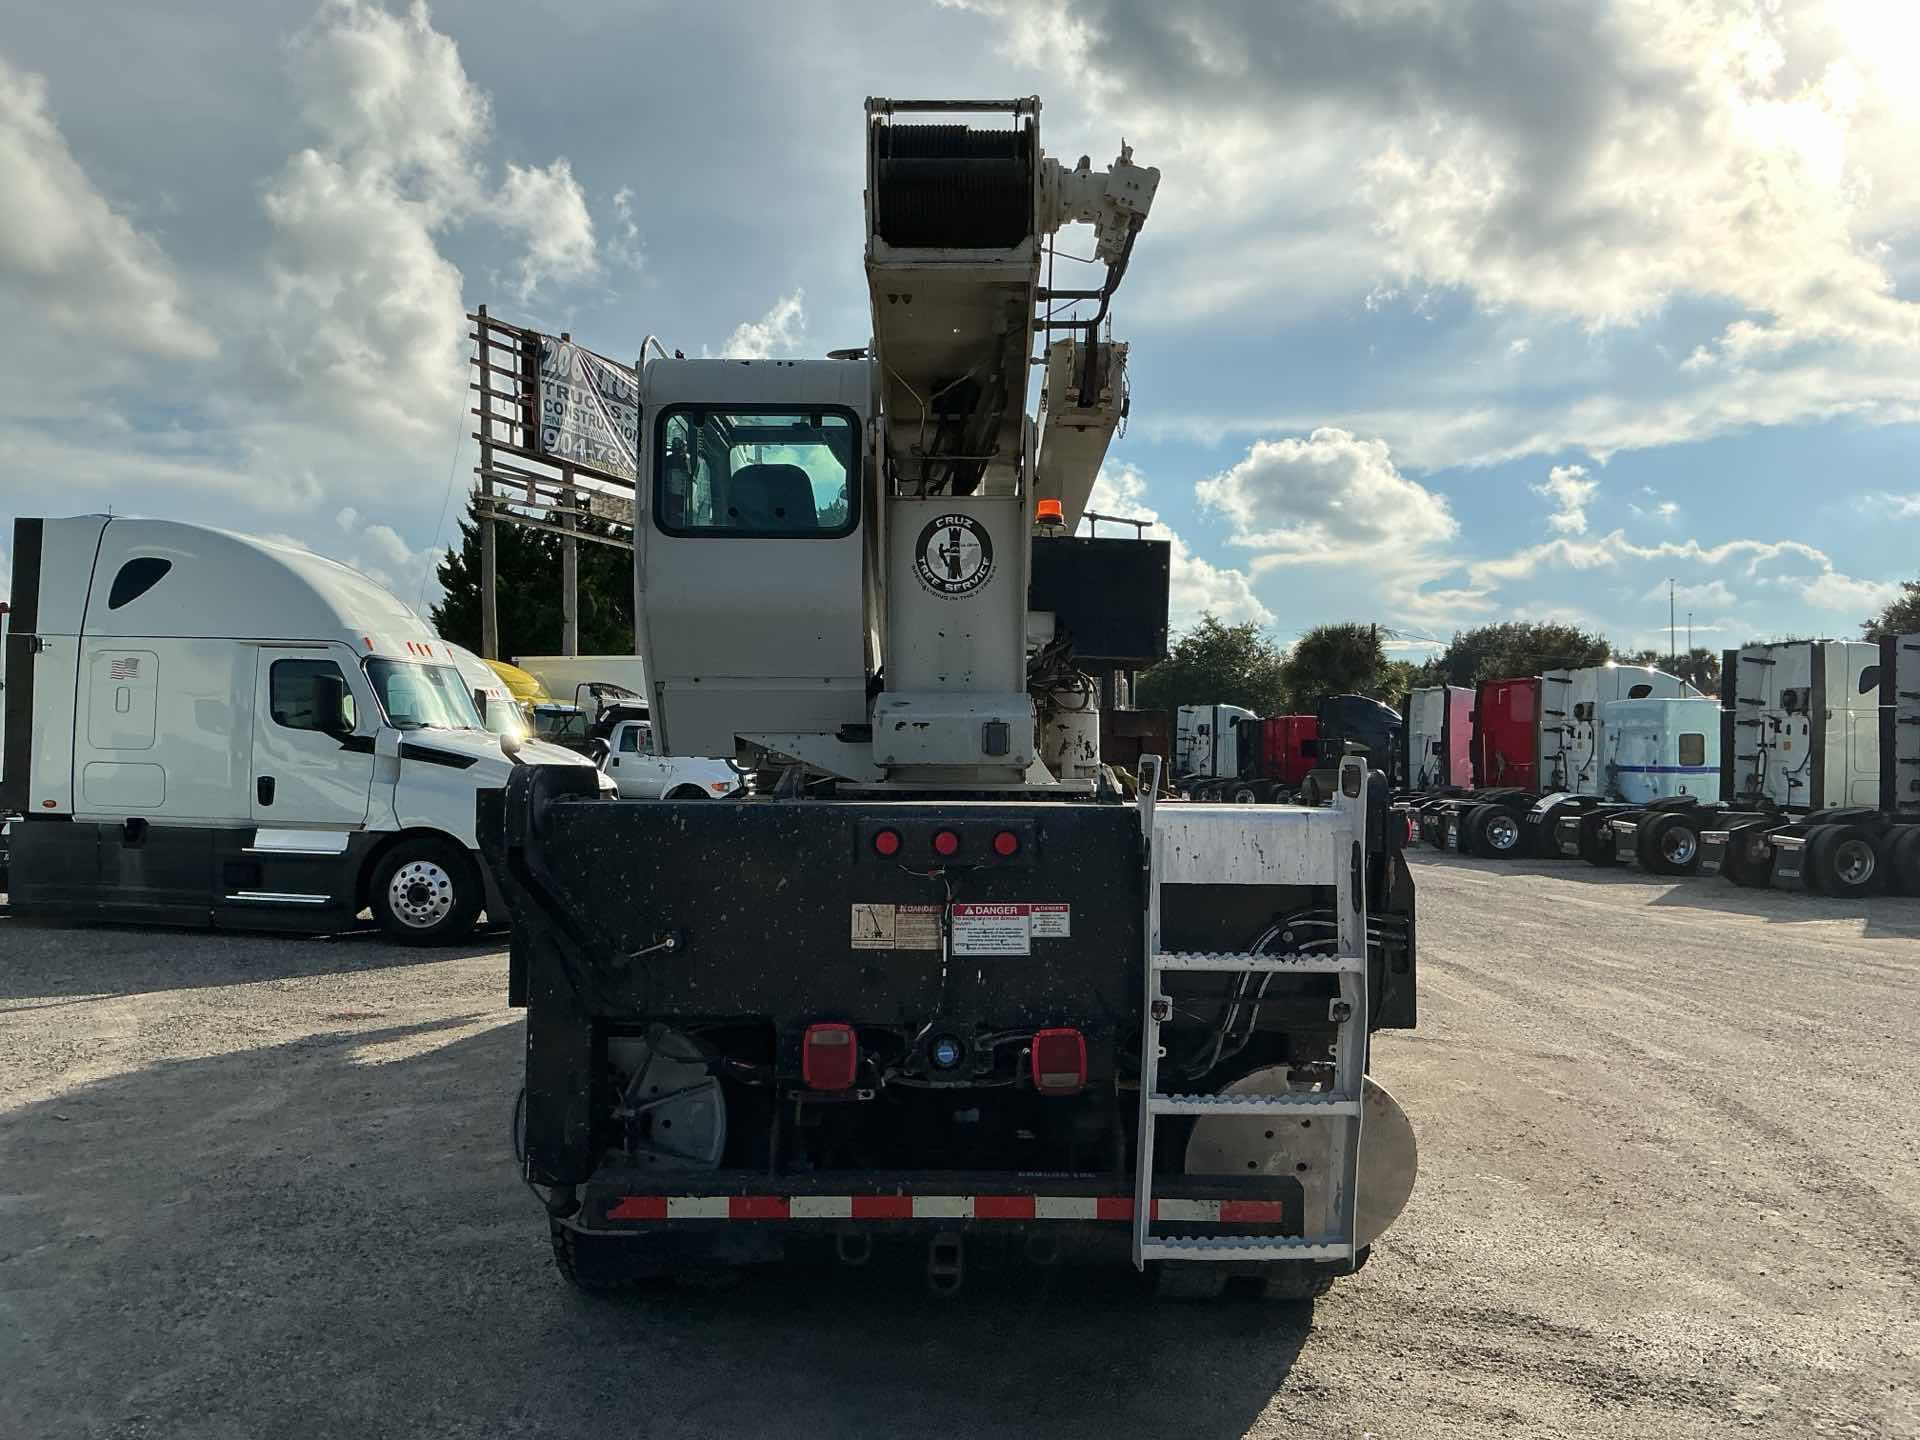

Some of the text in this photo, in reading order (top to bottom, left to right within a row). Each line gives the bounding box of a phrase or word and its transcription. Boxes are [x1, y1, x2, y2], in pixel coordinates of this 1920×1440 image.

[542, 380, 622, 420] TRUCS
[543, 398, 638, 443] CONSTRUIO
[935, 516, 974, 528] CRUZ
[919, 555, 941, 585] TREE
[944, 556, 990, 592] SERVICE
[907, 905, 939, 913] DANGE
[975, 905, 1018, 915] DANGER
